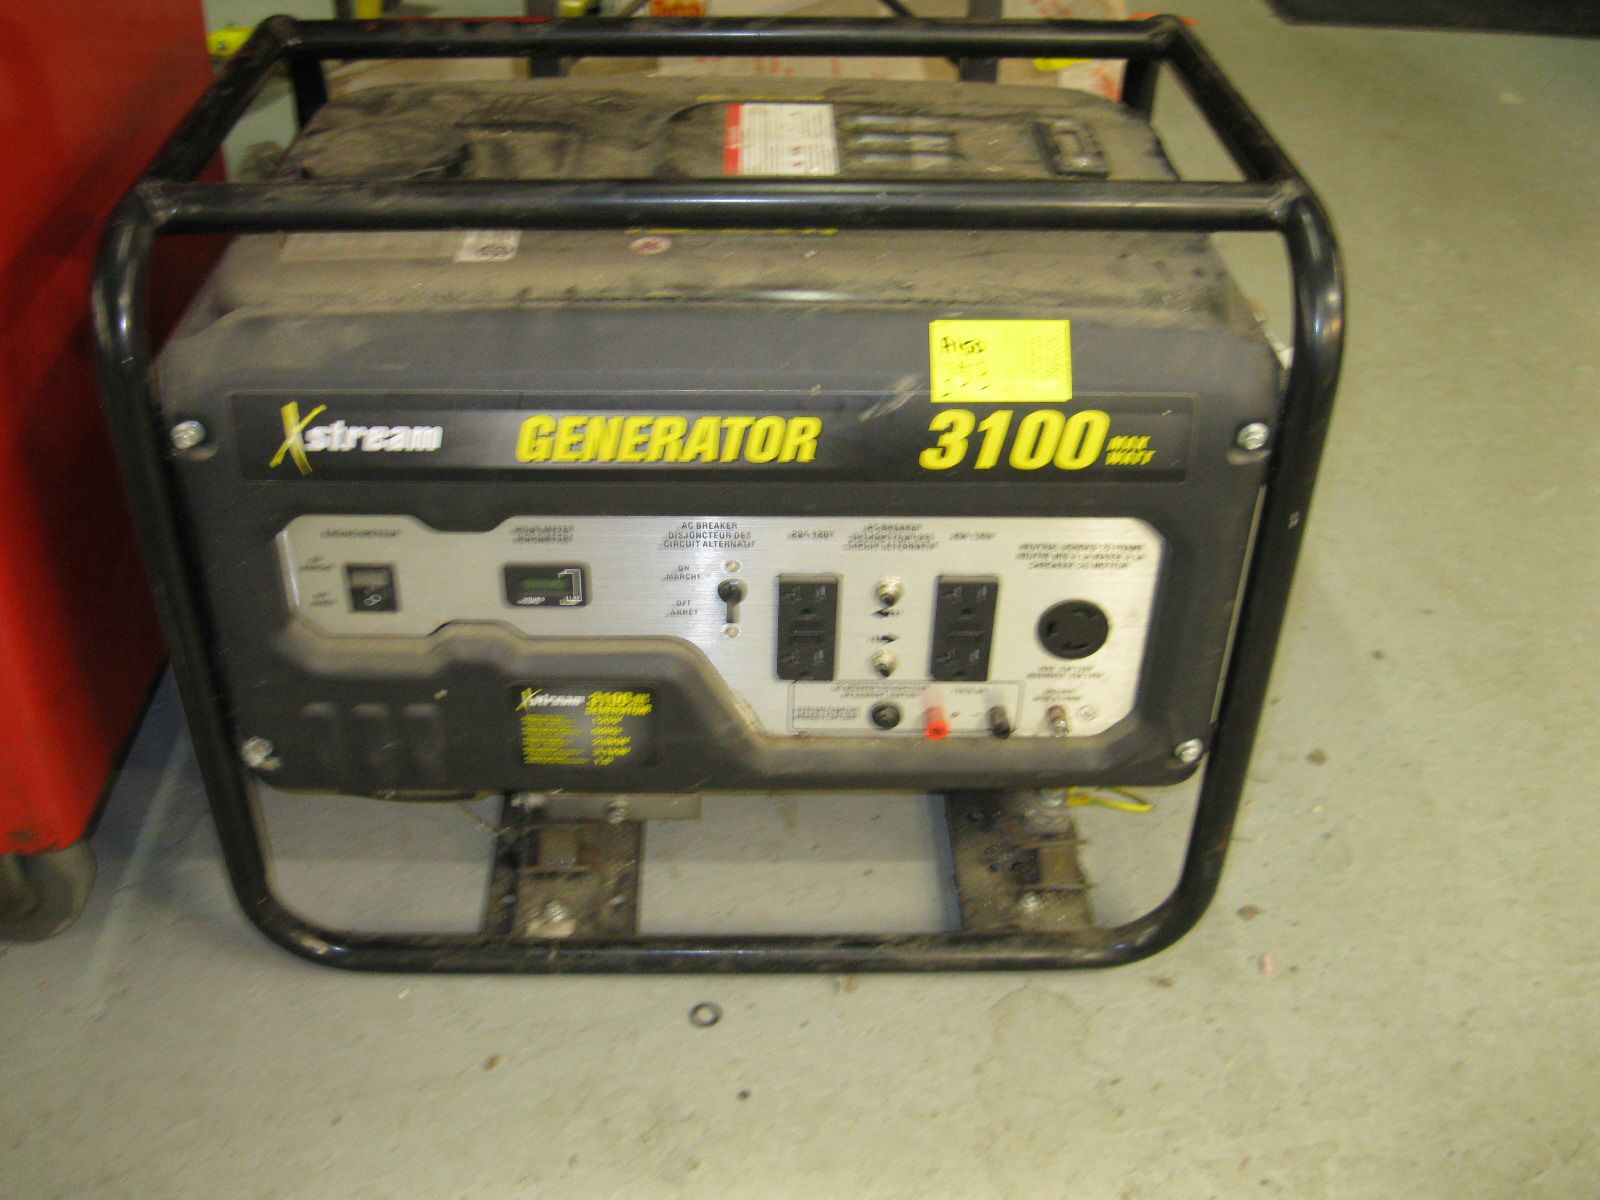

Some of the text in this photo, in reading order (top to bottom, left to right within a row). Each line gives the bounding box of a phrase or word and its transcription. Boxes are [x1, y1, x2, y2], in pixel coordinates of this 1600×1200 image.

[269, 401, 442, 475] Xstream
[515, 415, 822, 464] GENERATOR
[919, 409, 1111, 471] 3100
[668, 531, 752, 540] DISJONCTEUR DES
[681, 521, 738, 530] AC BREAKER
[663, 539, 700, 548] CIRCUIT
